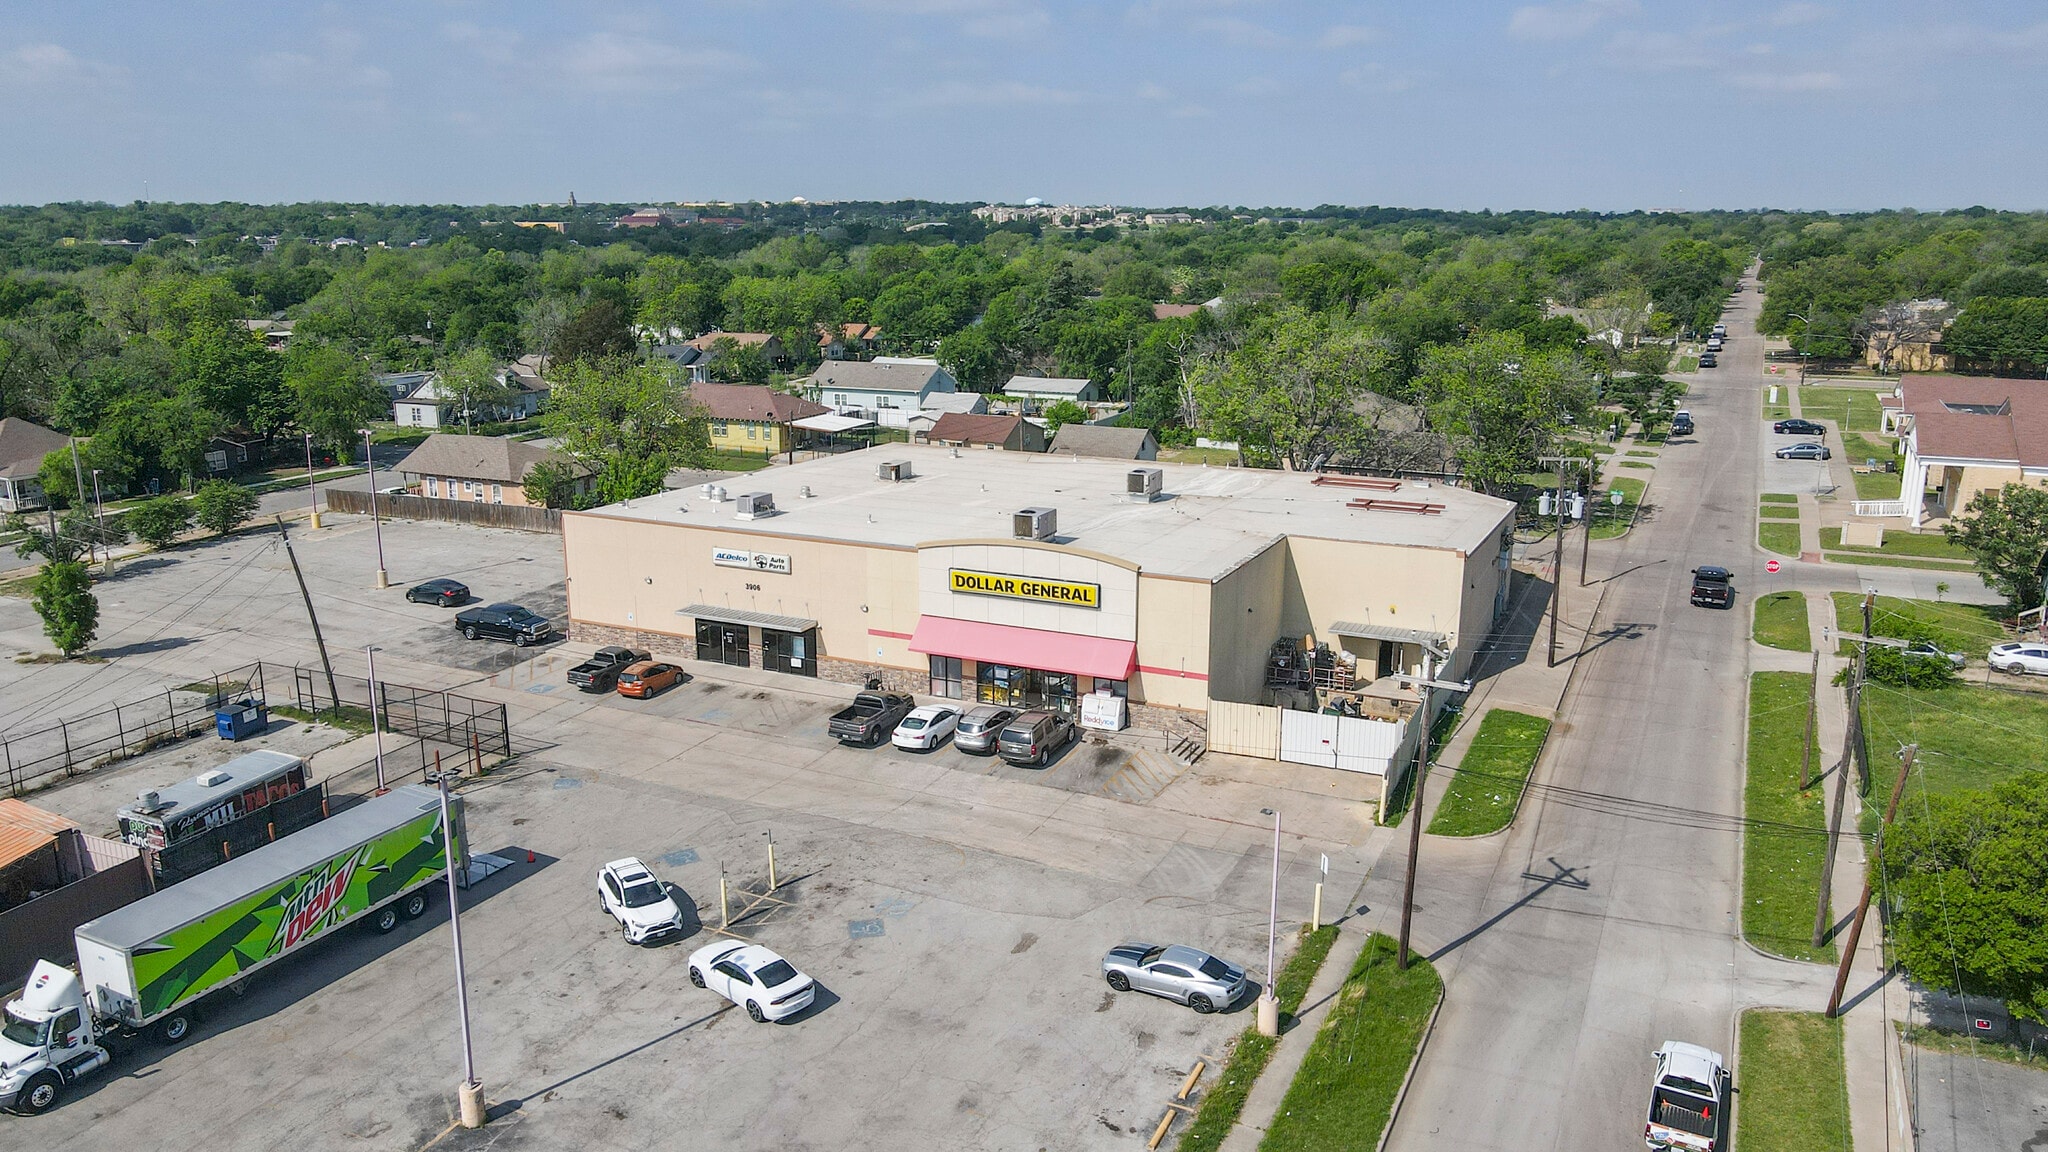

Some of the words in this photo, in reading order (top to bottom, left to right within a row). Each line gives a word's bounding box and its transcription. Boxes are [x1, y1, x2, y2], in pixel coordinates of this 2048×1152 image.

[716, 552, 748, 562] ACDelco
[769, 562, 785, 570] Parts
[745, 583, 761, 591] 3906
[954, 574, 1015, 594] DOLLAR
[1020, 582, 1092, 602] GENERAL
[244, 782, 300, 812] TACOS
